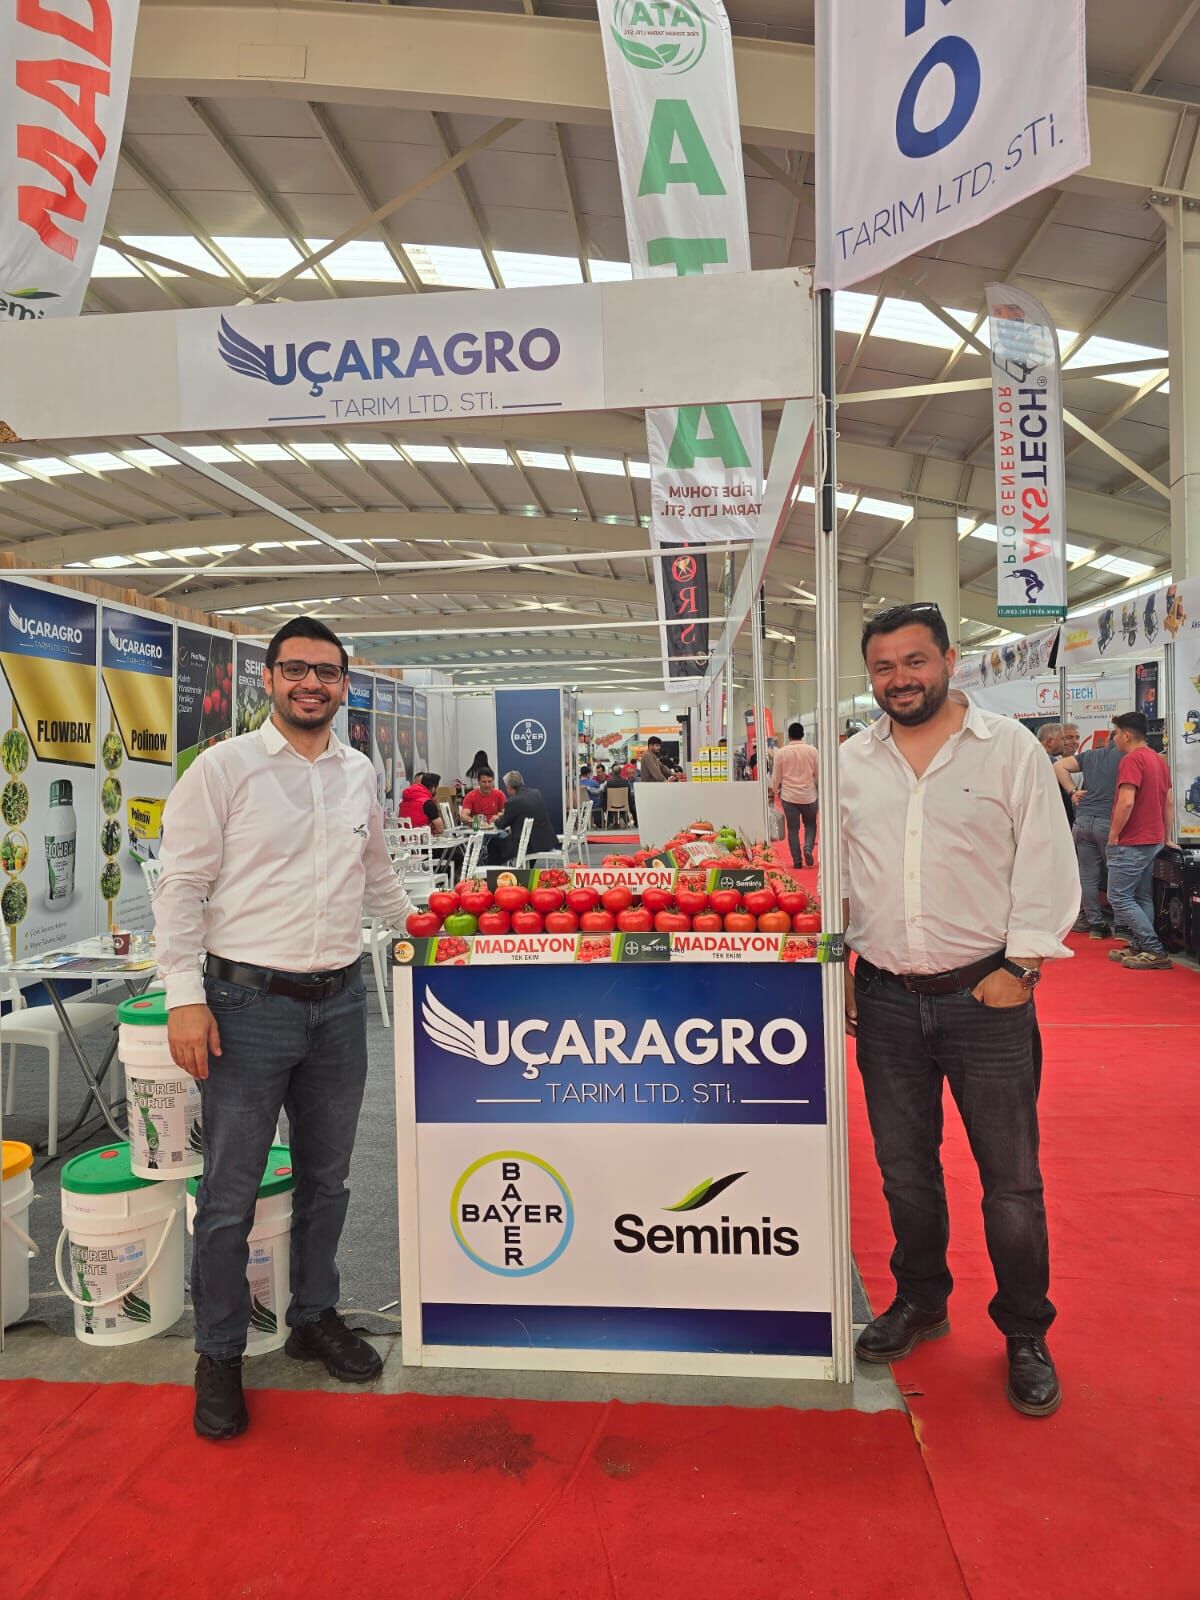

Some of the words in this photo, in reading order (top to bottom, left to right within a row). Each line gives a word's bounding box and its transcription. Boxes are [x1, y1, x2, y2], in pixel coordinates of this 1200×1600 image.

[836, 192, 925, 260] TARIM
[936, 161, 995, 214] LTD.
[264, 327, 561, 397] UÇARAGRO
[329, 396, 400, 418] TARIM
[409, 393, 453, 415] LTD.
[19, 616, 83, 644] UÇARAGRO
[116, 636, 163, 659] UÇARAGRO
[239, 676, 256, 687] ERKEN
[37, 720, 91, 743] FLOWBAX
[131, 729, 167, 751] Polinow
[514, 733, 544, 741] BAYER
[575, 871, 672, 887] MADALYON
[475, 938, 575, 954] MADALYON
[674, 937, 779, 952] MADALYON
[712, 952, 725, 960] TEK
[472, 1017, 809, 1080] UÇARAGRO
[546, 1082, 625, 1105] TARIM
[634, 1082, 685, 1104] LTD.
[461, 1203, 564, 1224] BAYER
[500, 1162, 524, 1266] BAYER
[613, 1213, 800, 1257] Seminis
